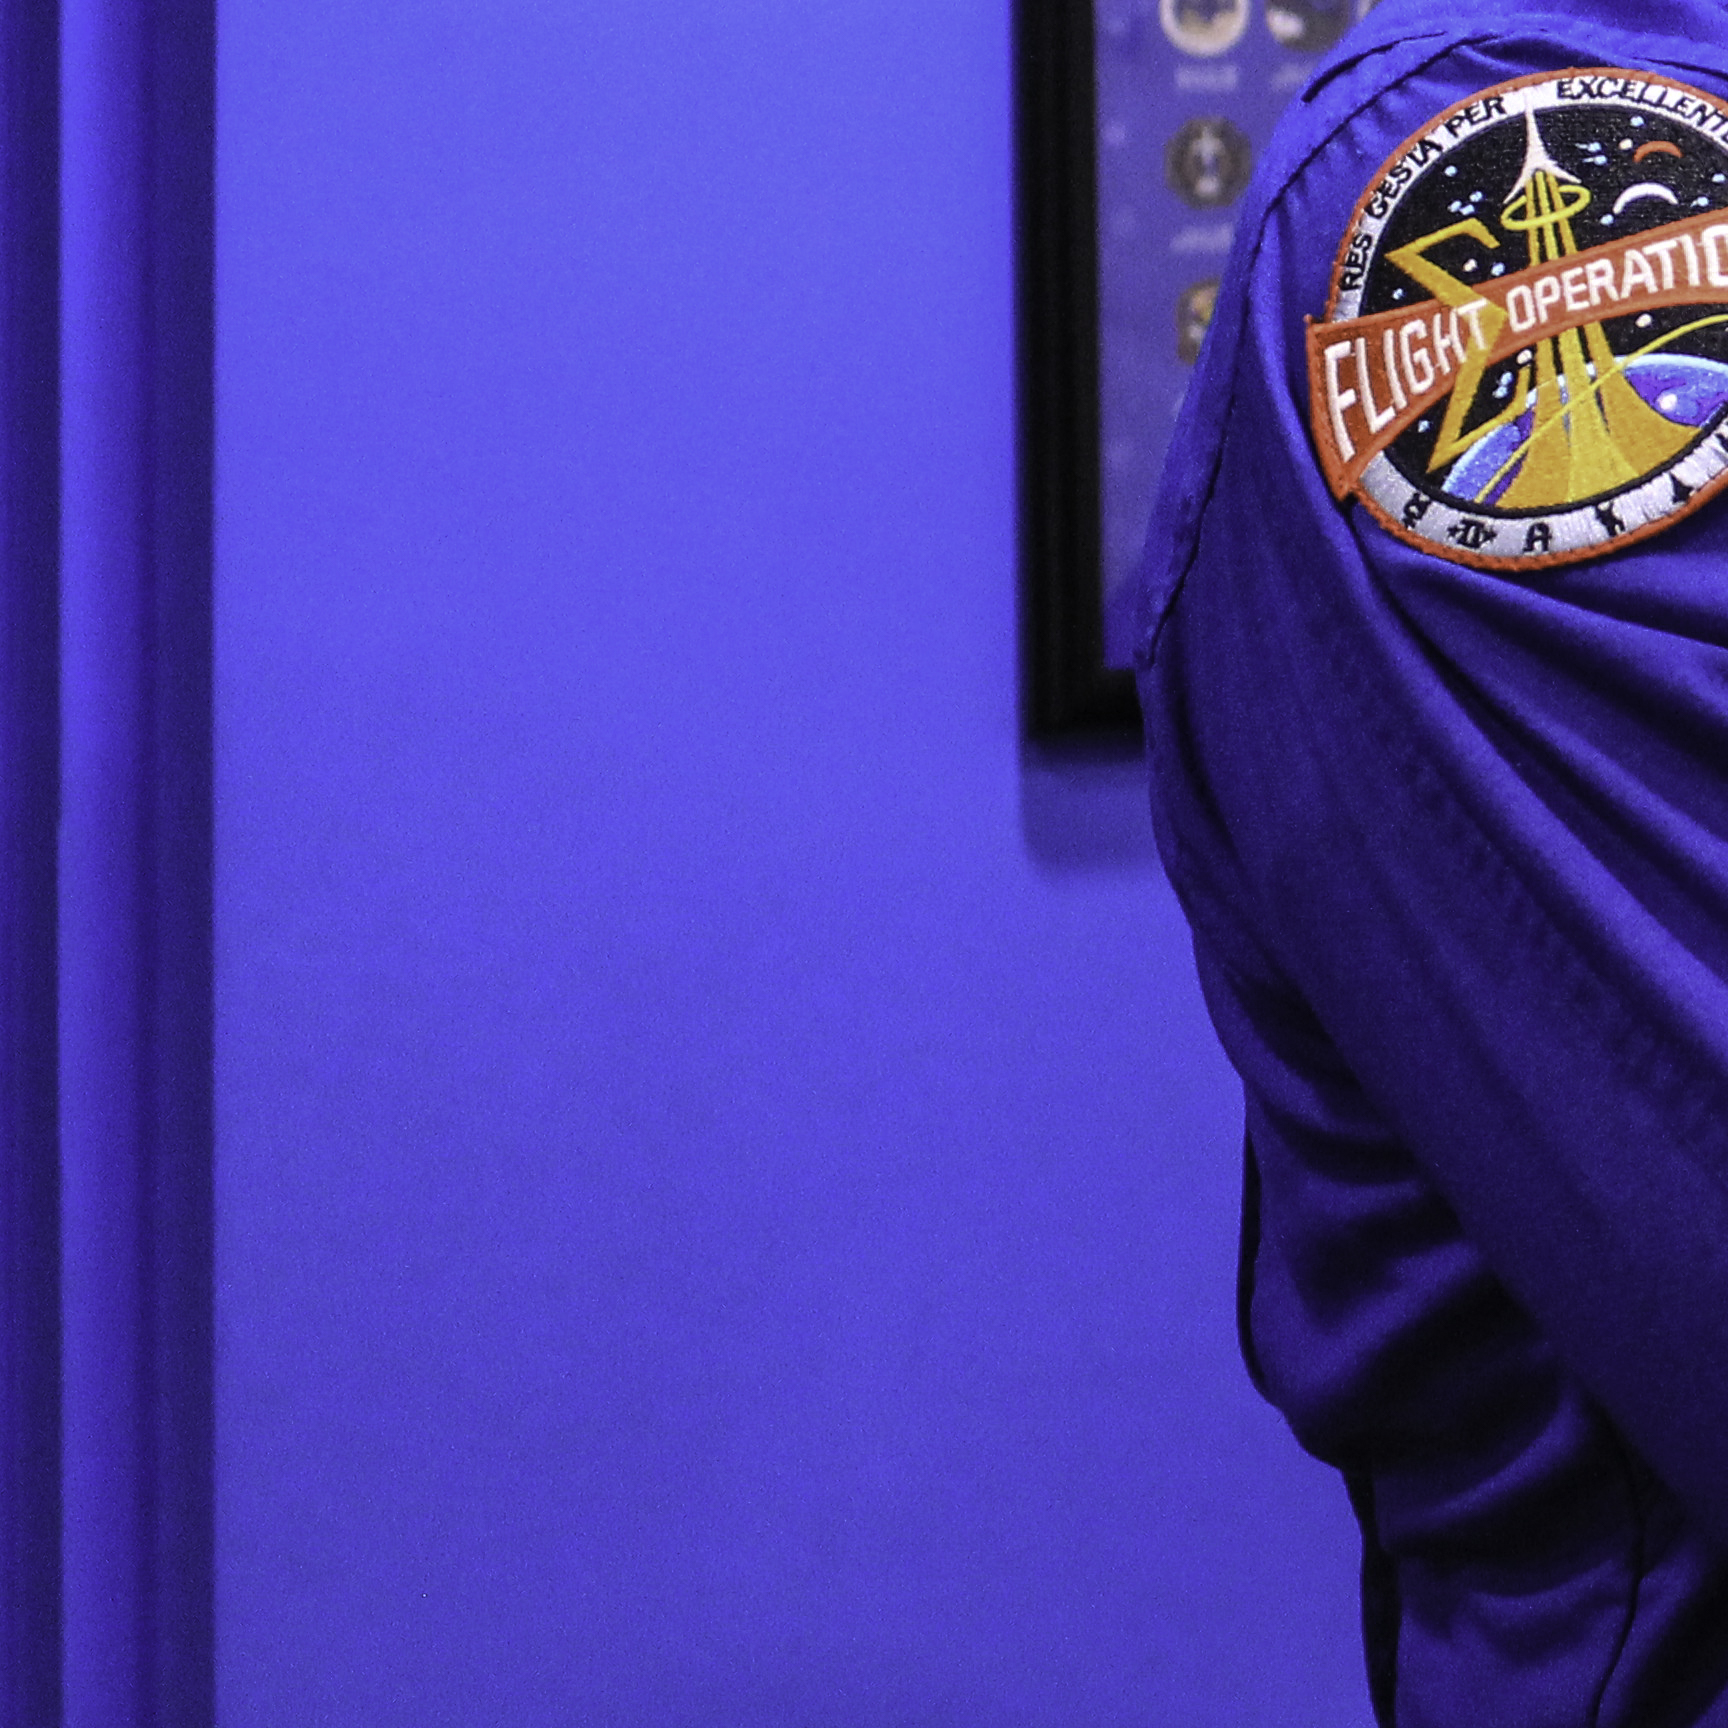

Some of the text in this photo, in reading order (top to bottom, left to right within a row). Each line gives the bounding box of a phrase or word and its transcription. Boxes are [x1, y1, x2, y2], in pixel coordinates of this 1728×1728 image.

[1340, 232, 1373, 294] RES
[1366, 137, 1443, 219] GESTA
[1446, 96, 1508, 137] PER
[1322, 298, 1489, 464] FLIGHT
